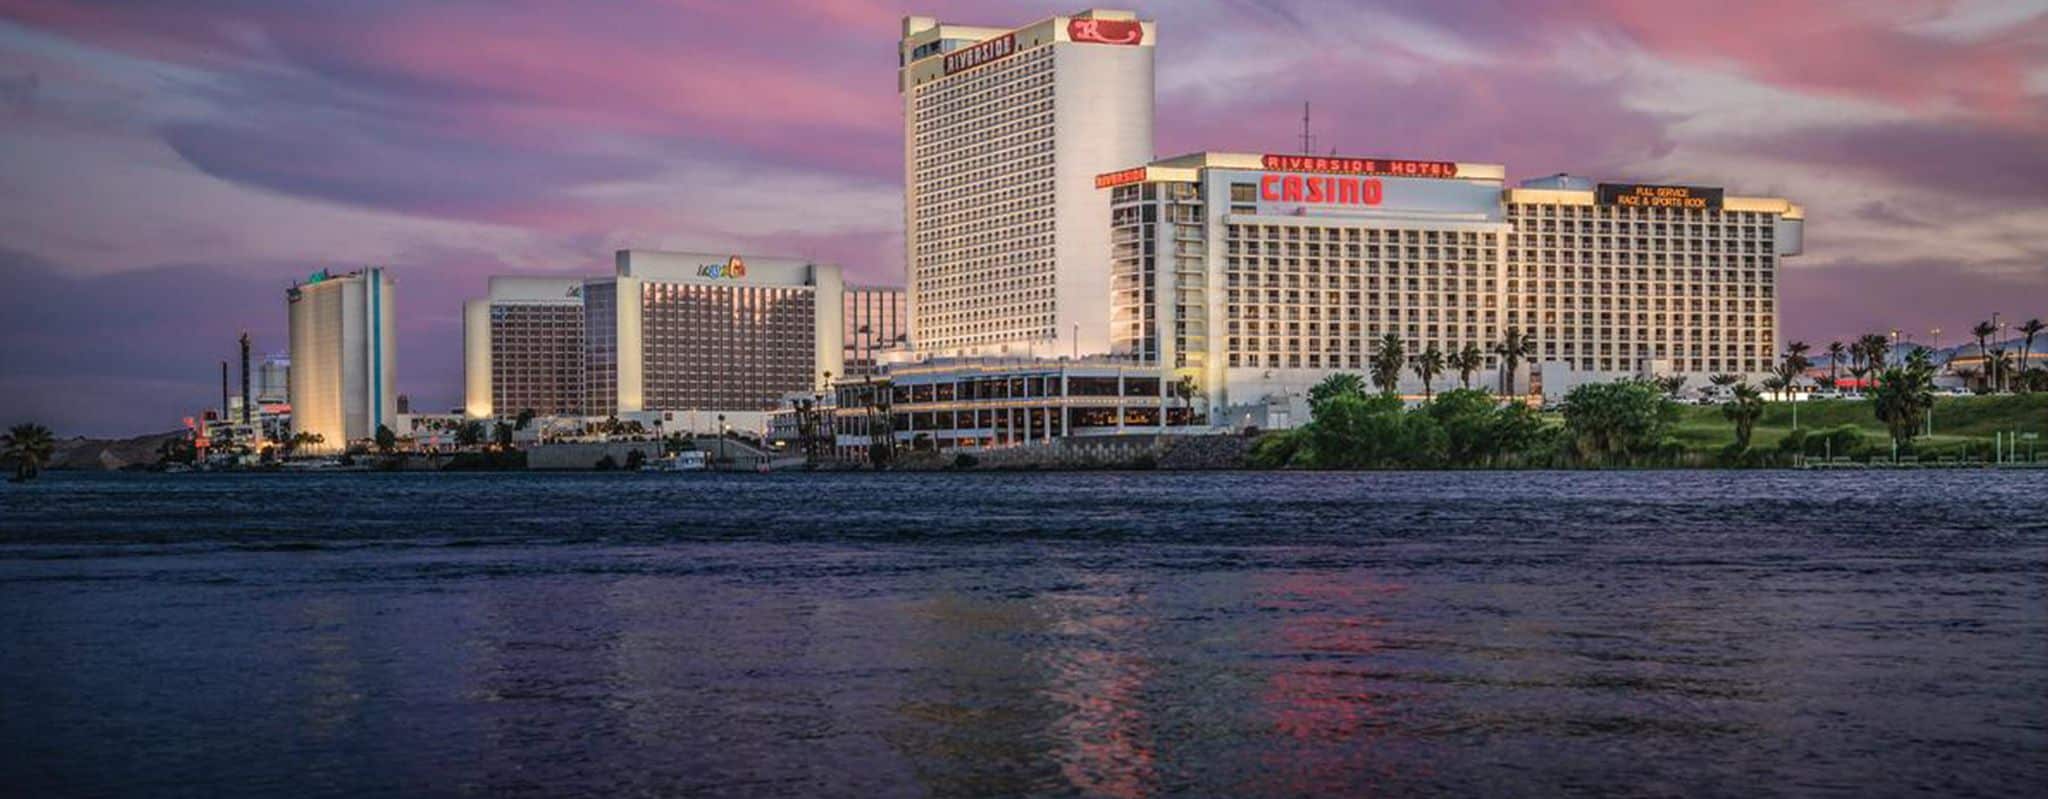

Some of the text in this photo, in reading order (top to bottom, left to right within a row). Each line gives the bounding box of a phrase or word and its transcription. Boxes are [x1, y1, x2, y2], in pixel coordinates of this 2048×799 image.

[946, 35, 1012, 73] RIVERSIDE
[1267, 156, 1453, 176] RIVERSIDE HOTEL
[1261, 173, 1384, 206] CASINO
[1636, 187, 1655, 196] FULL
[1618, 195, 1641, 206] RACE
[1651, 196, 1682, 207] SPORTS
[1684, 198, 1707, 208] BOOK
